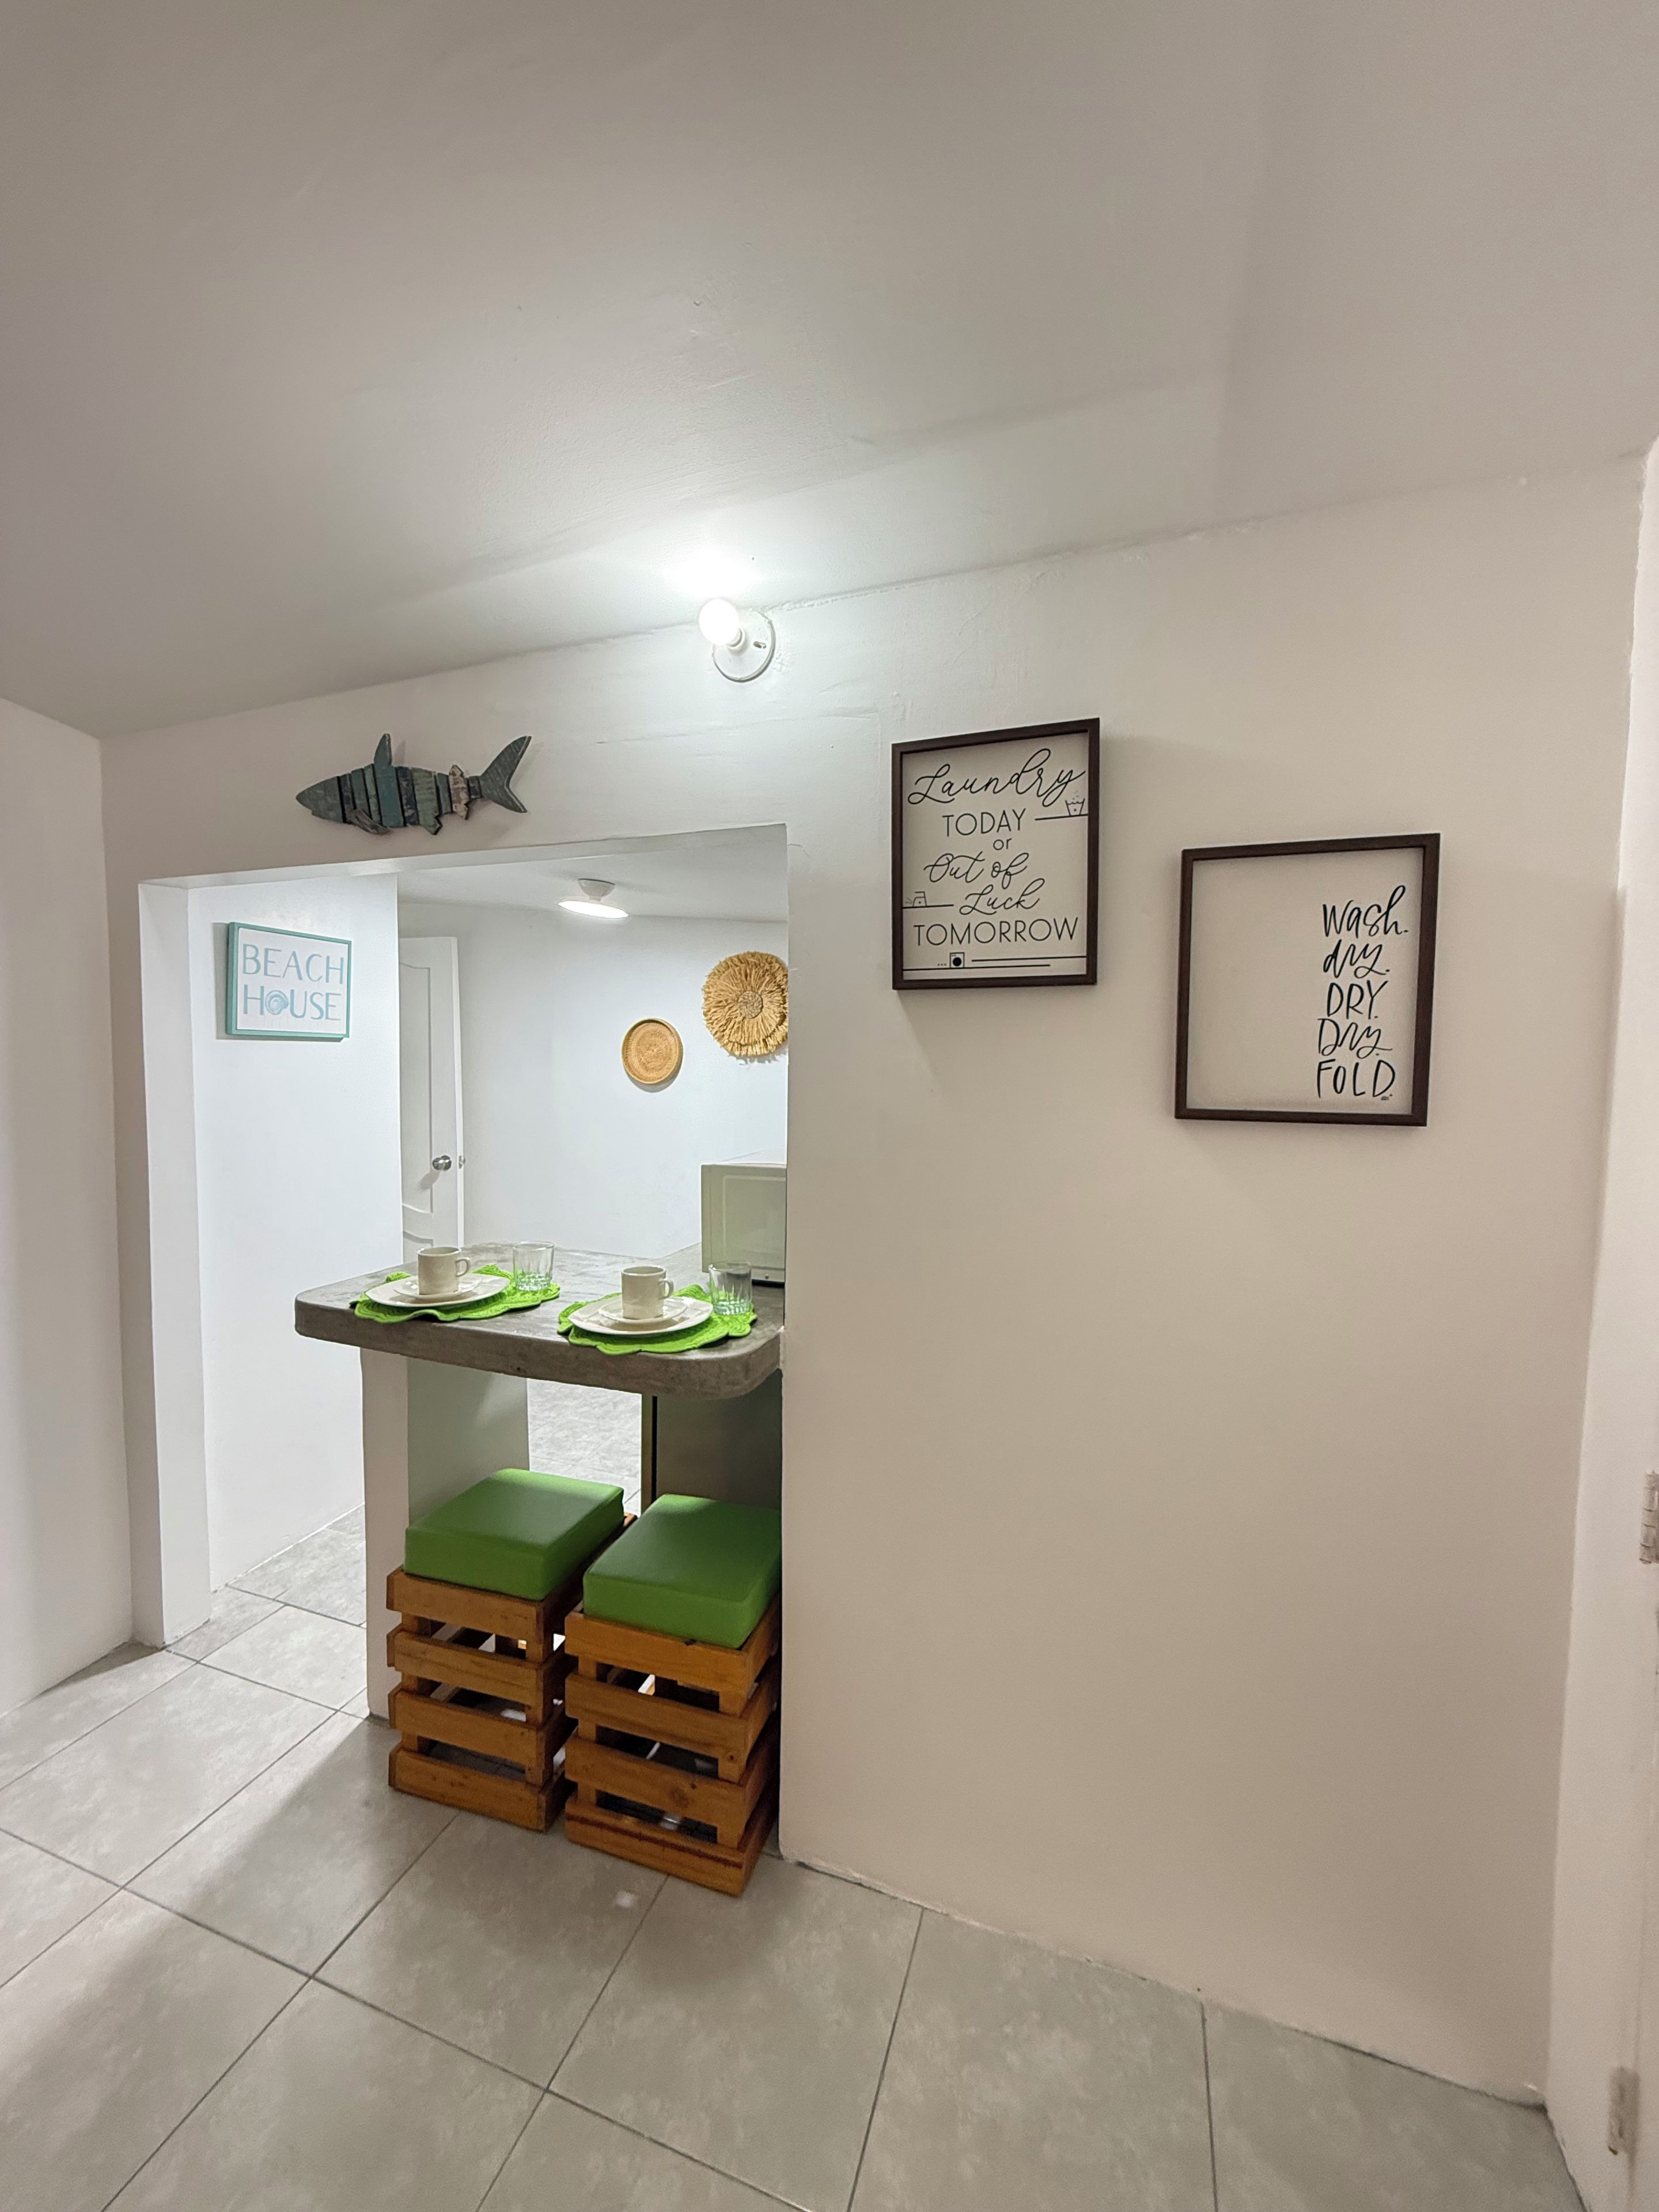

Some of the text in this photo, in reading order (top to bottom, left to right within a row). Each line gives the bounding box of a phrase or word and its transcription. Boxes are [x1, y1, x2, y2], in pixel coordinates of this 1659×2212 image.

[908, 748, 1086, 807] Laundry
[942, 808, 1026, 836] TODAY
[993, 838, 1012, 850] or
[923, 850, 1029, 889] Out of
[959, 878, 1045, 915] Luck
[913, 917, 1078, 946] TOMORROW
[242, 943, 344, 984] BEACH
[243, 984, 342, 1021] HOUSE
[1327, 980, 1389, 1020] DRY.
[1317, 1059, 1396, 1099] FOLD.
